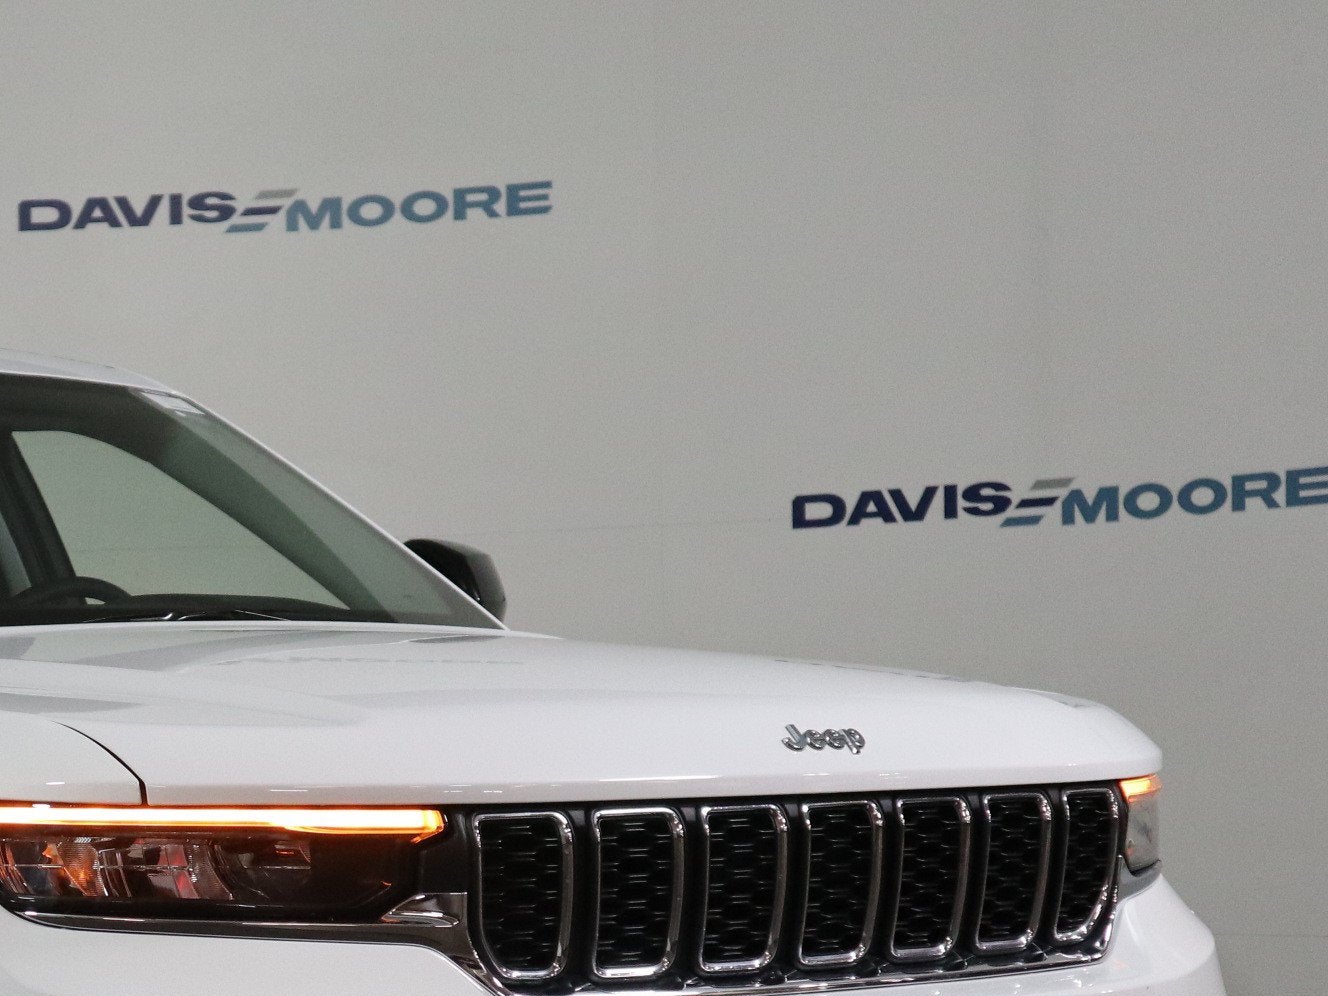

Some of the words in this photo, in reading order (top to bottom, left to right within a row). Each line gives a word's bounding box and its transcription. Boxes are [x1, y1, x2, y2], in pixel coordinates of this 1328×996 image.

[17, 190, 238, 232] DAVIS
[285, 180, 553, 232] MOORE
[791, 481, 1012, 529] DAVIS
[1062, 466, 1328, 526] MOORE
[781, 723, 866, 755] Jeep
